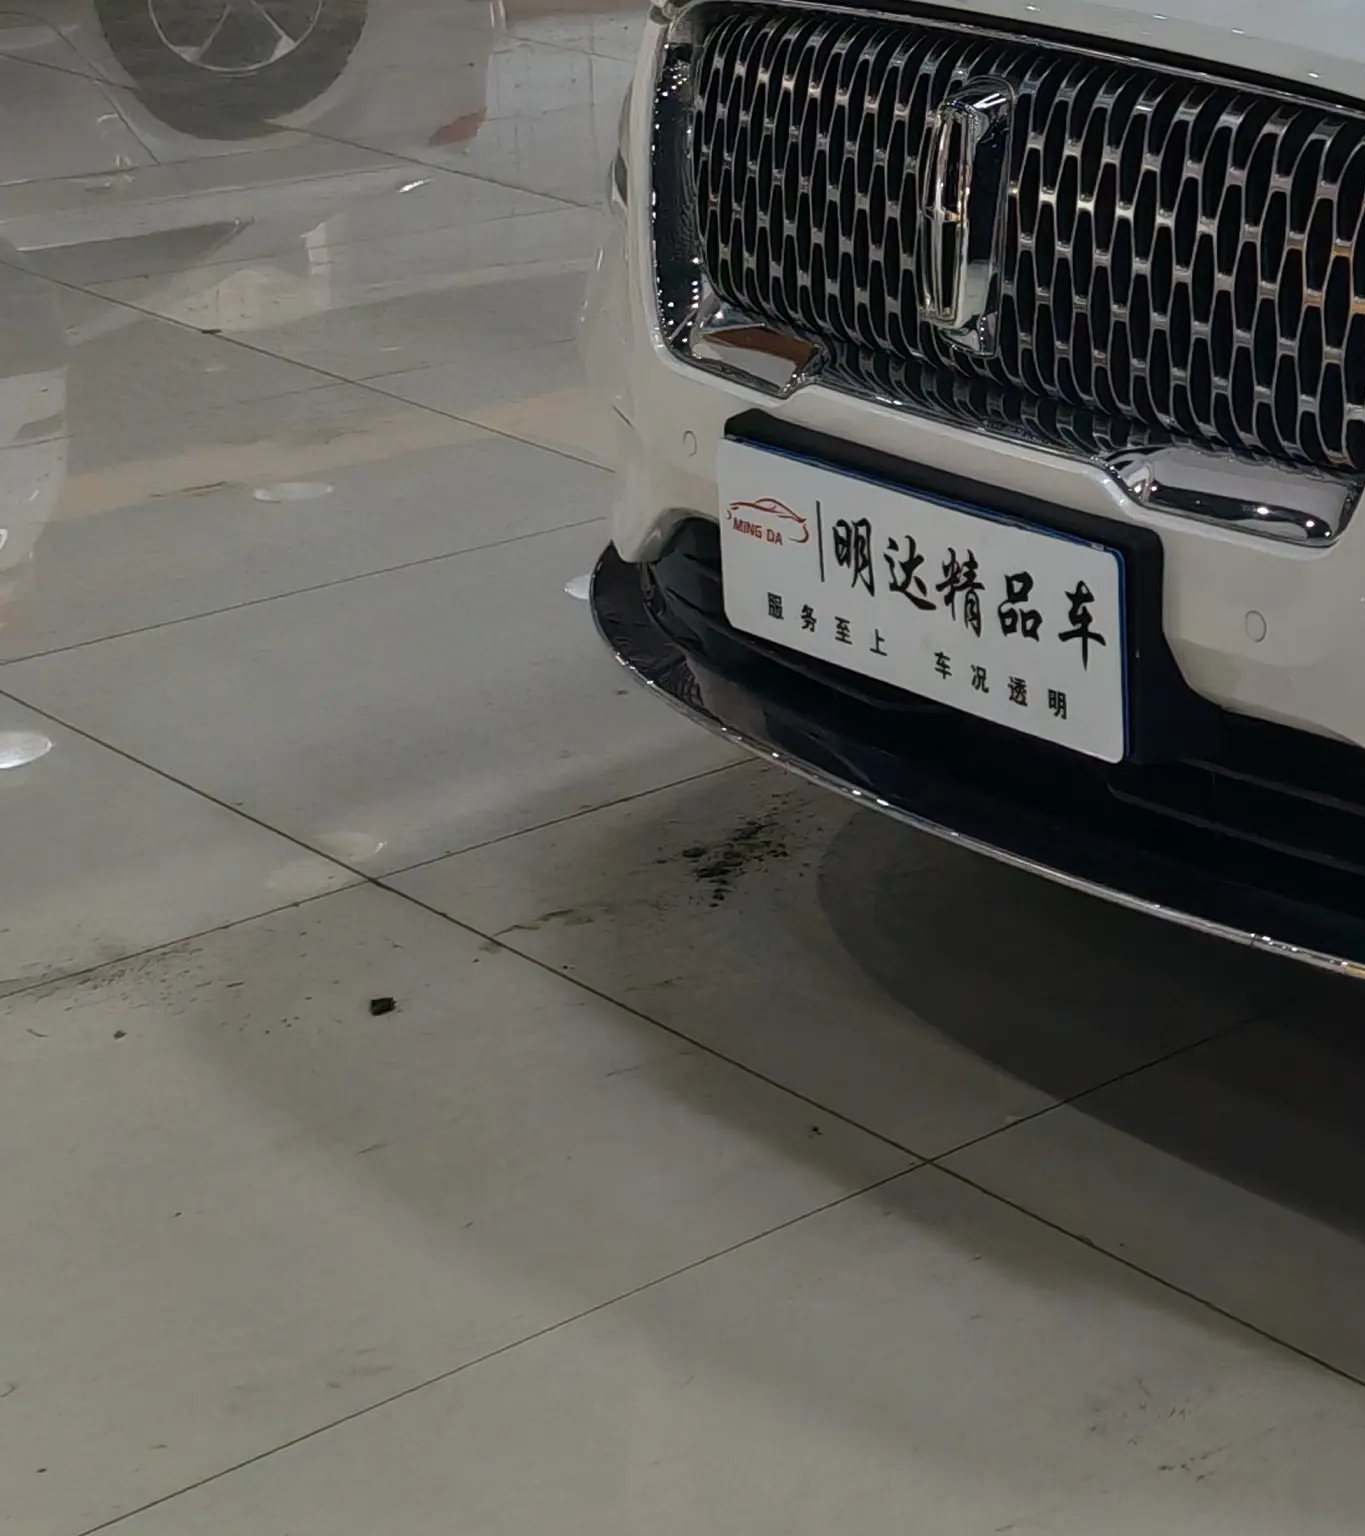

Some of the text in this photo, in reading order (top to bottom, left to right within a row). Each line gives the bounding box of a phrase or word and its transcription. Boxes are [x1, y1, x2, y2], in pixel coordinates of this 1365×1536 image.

[733, 517, 783, 546] MING DA
[767, 592, 888, 657] 服务至上
[832, 516, 1106, 670] 明达精品车
[934, 651, 1068, 720] 车况透明
